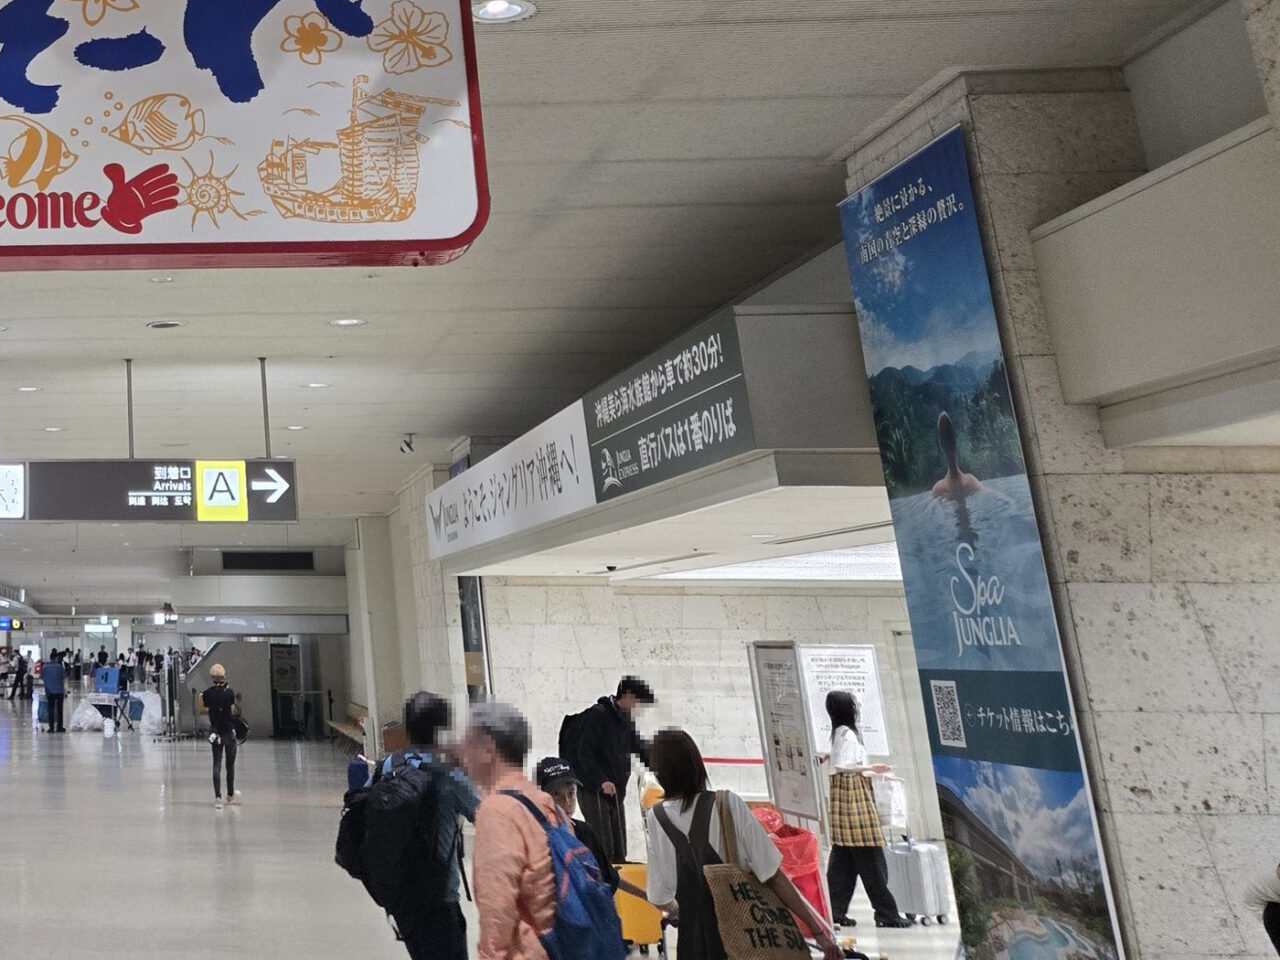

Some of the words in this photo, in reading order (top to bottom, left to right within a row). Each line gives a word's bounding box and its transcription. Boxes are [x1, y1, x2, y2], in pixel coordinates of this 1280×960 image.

[154, 466, 191, 480] 到着口
[153, 480, 191, 491] Arrivals
[208, 471, 236, 501] A
[950, 542, 1005, 615] Spa
[12, 619, 21, 629] 6
[952, 611, 1022, 657] JUNGLIA
[744, 927, 781, 949] THE
[783, 928, 807, 951] SU
